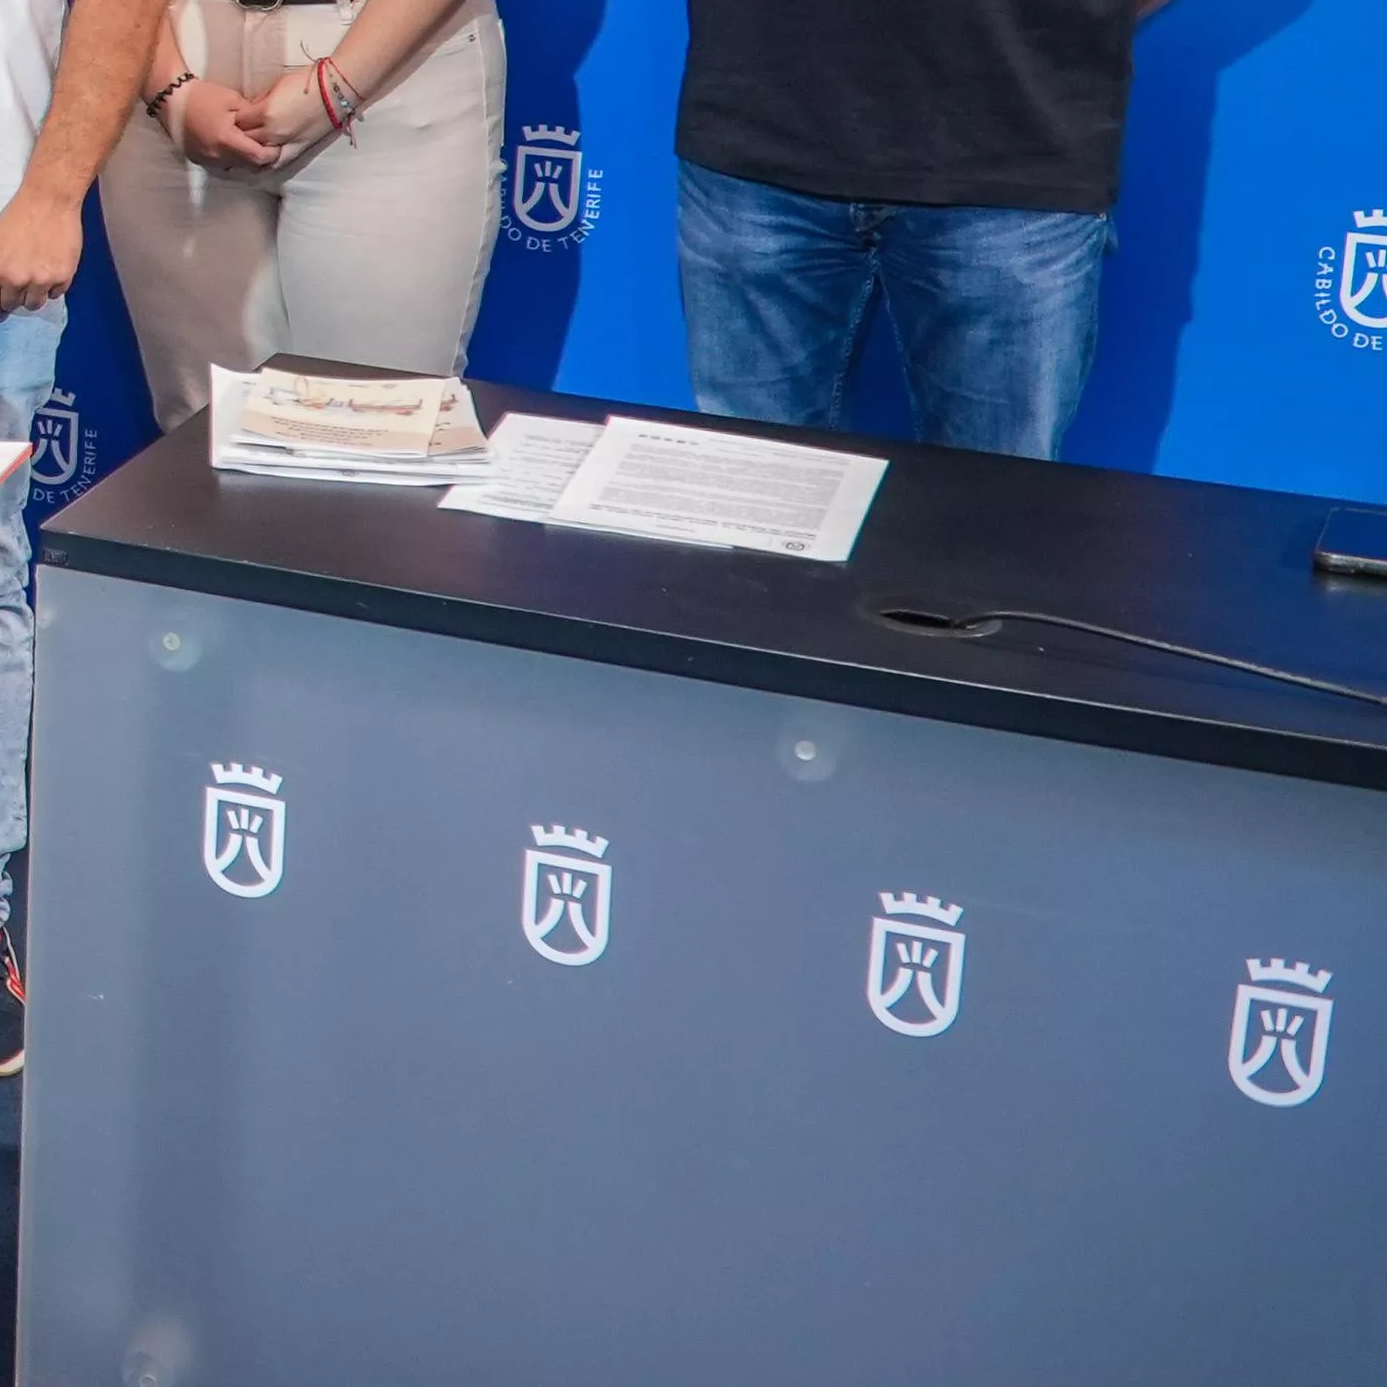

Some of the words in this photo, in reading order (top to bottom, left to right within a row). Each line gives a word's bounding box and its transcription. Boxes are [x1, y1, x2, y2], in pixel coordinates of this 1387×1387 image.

[527, 237, 552, 252] DE
[558, 170, 603, 249] TENERIFE
[1315, 246, 1348, 338] CABILDO
[1352, 333, 1383, 350] DE
[33, 488, 55, 504] DE
